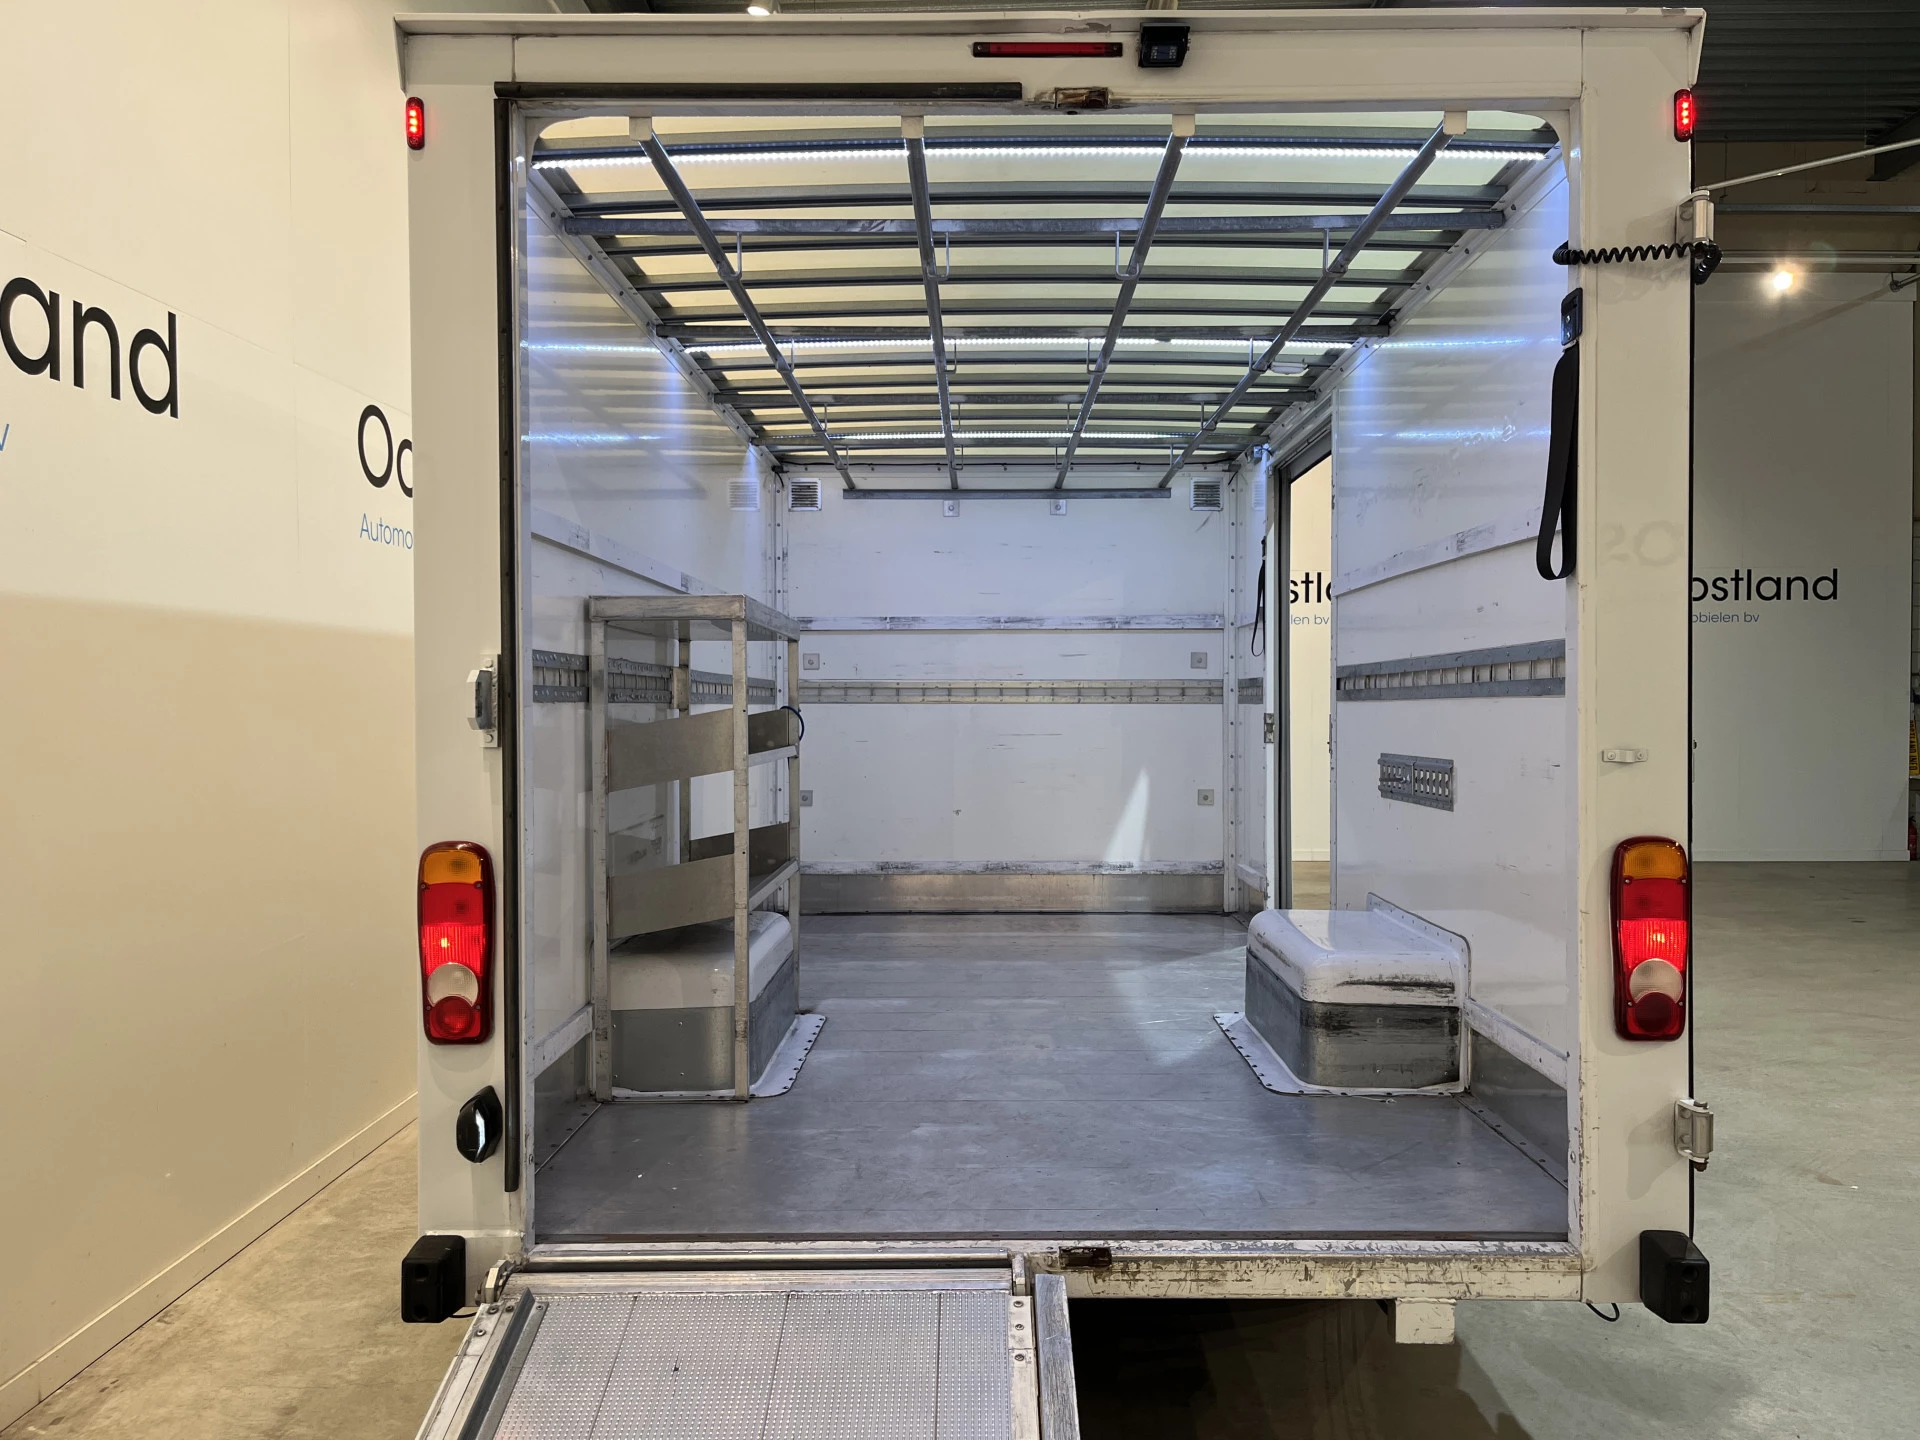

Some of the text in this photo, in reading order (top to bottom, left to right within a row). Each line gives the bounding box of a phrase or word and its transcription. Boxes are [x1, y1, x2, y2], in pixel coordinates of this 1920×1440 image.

[0, 277, 179, 419] and
[360, 513, 413, 549] Automo
[1290, 572, 1331, 604] stl
[1290, 614, 1330, 625] len bv
[1743, 612, 1760, 623] bv
